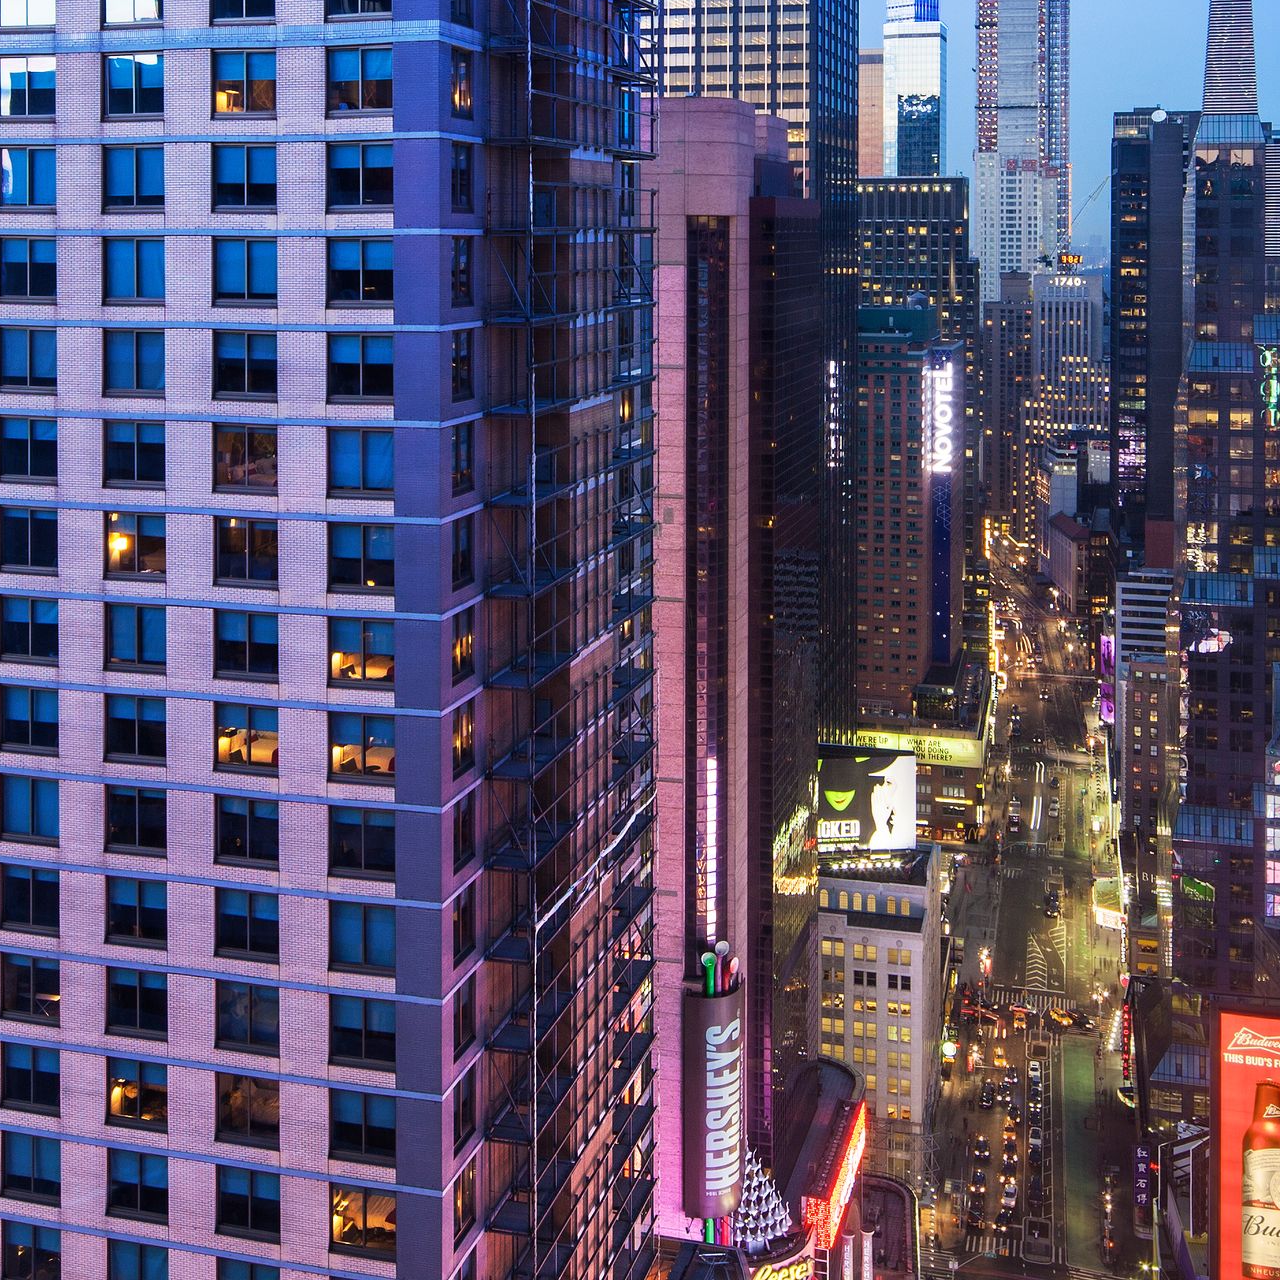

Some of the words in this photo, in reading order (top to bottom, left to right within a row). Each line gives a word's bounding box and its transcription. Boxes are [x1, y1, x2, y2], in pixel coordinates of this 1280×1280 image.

[1054, 277, 1082, 286] 1740
[932, 362, 953, 472] NOVOTEL
[907, 738, 926, 746] WHAT
[928, 740, 941, 748] ARE
[912, 745, 926, 753] YOU
[927, 747, 950, 755] DOING
[927, 753, 953, 762] THERE?
[817, 818, 860, 839] ICKED
[1223, 1052, 1244, 1064] THIS
[1246, 1055, 1273, 1068] BUD'S
[706, 1018, 741, 1190] HERSHEY'S
